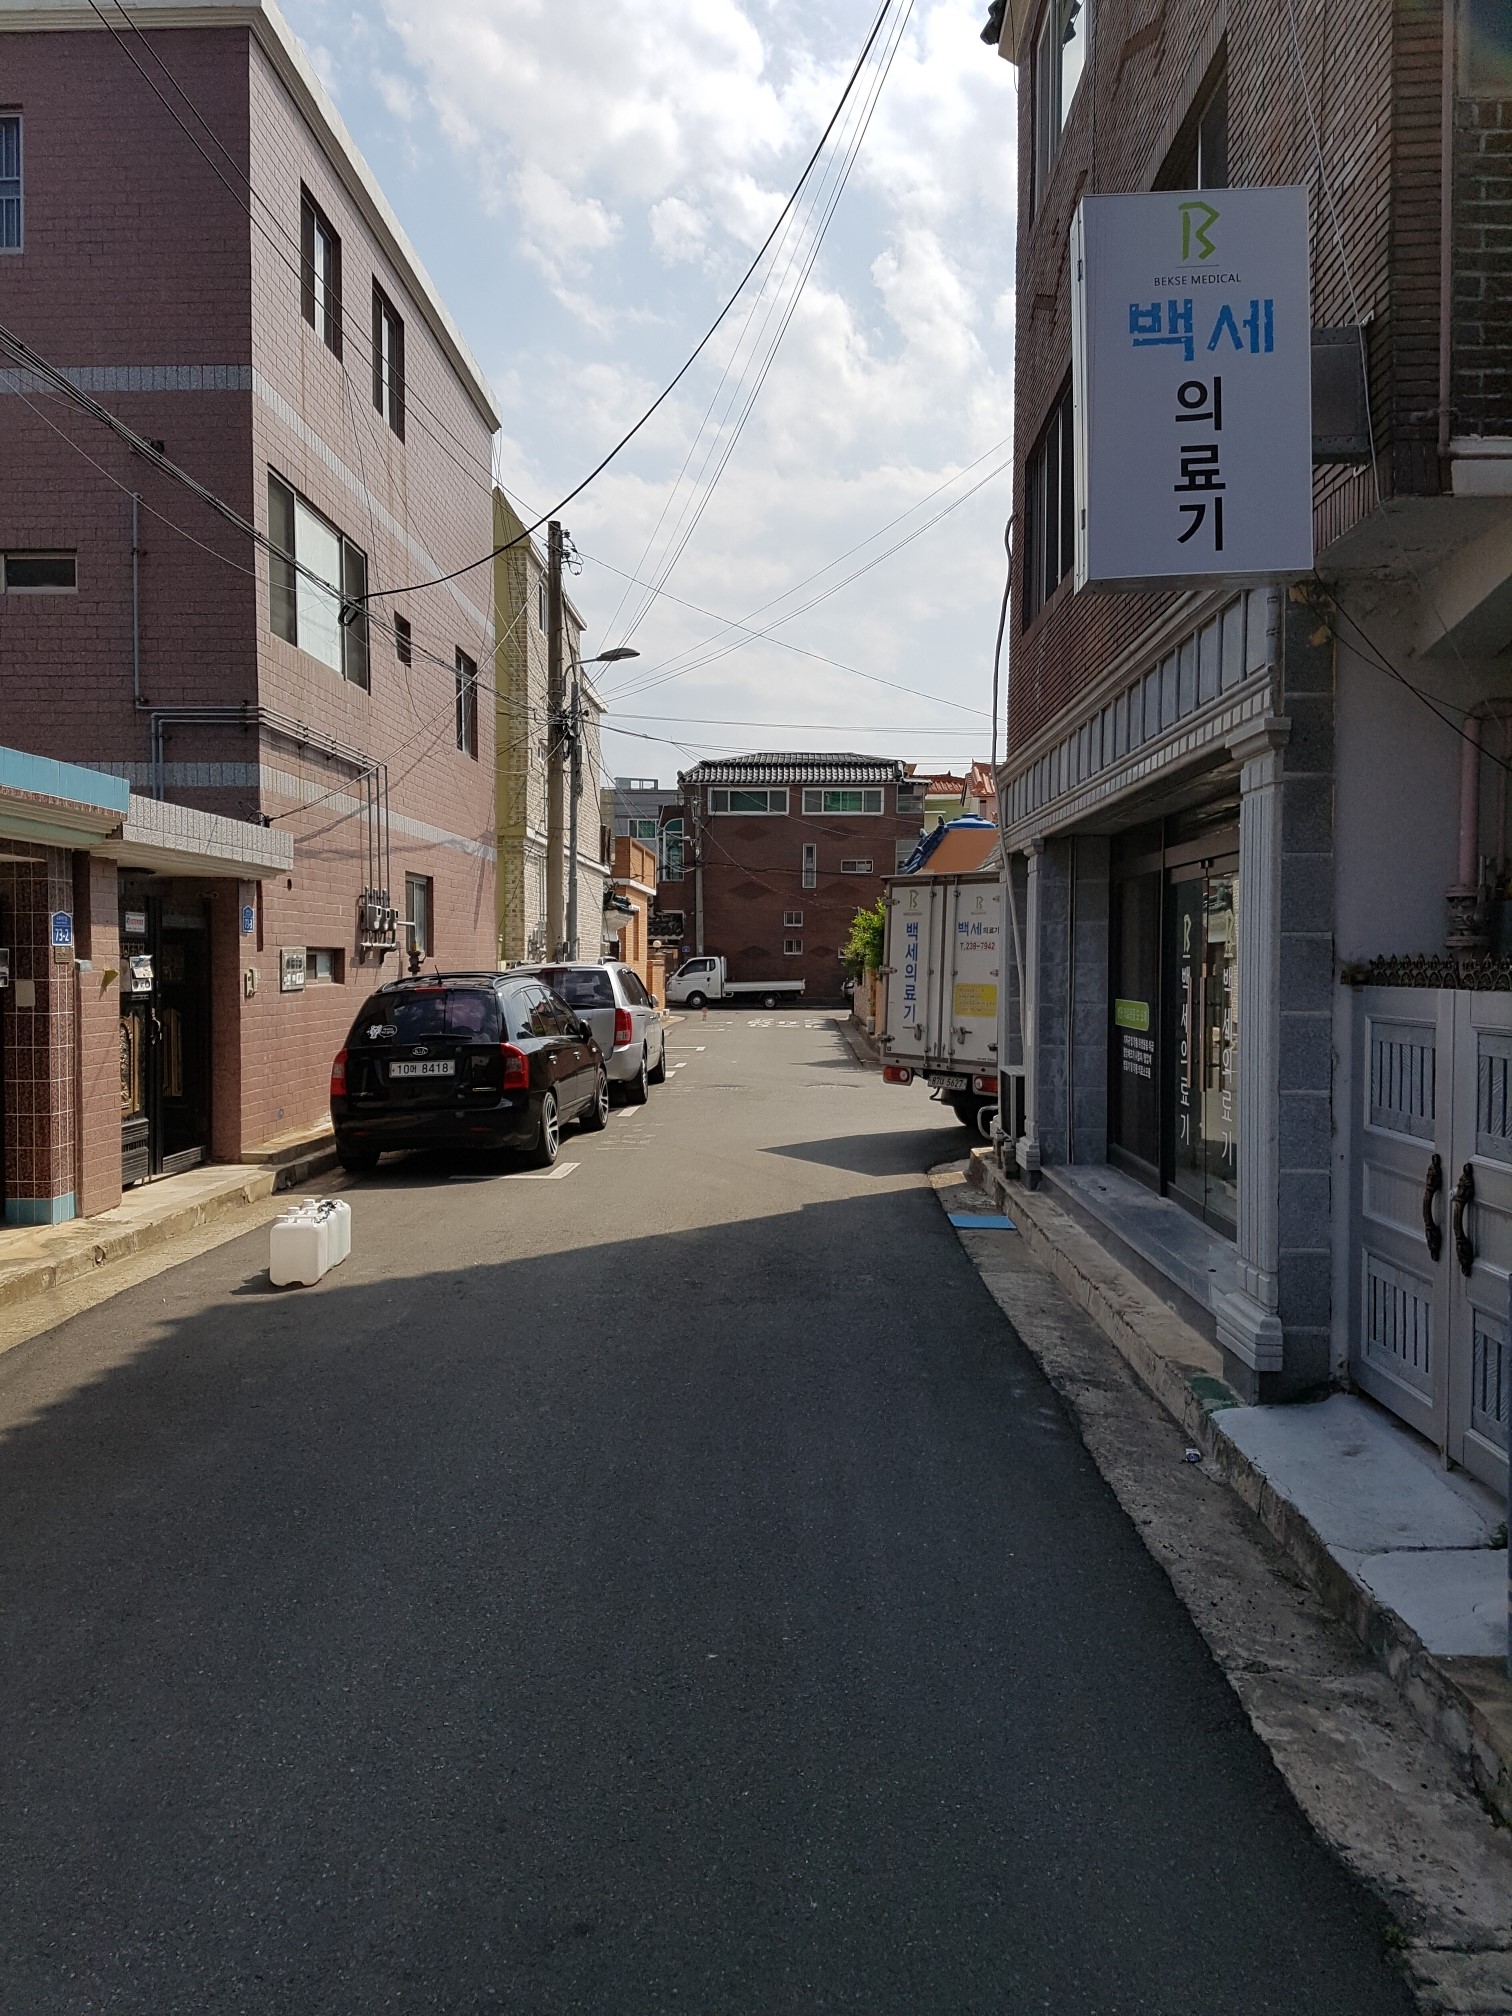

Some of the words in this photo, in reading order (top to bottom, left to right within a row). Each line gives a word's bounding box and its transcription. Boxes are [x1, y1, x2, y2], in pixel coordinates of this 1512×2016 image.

[1153, 276, 1188, 287] BEKSE
[1190, 273, 1242, 285] MEDICAL
[1129, 298, 1275, 362] 백세
[1173, 375, 1227, 553] 의료기
[55, 928, 70, 942] 73-2
[903, 922, 919, 1023] 백세의료기
[421, 1062, 448, 1073] 8418
[946, 1078, 964, 1088] 5627
